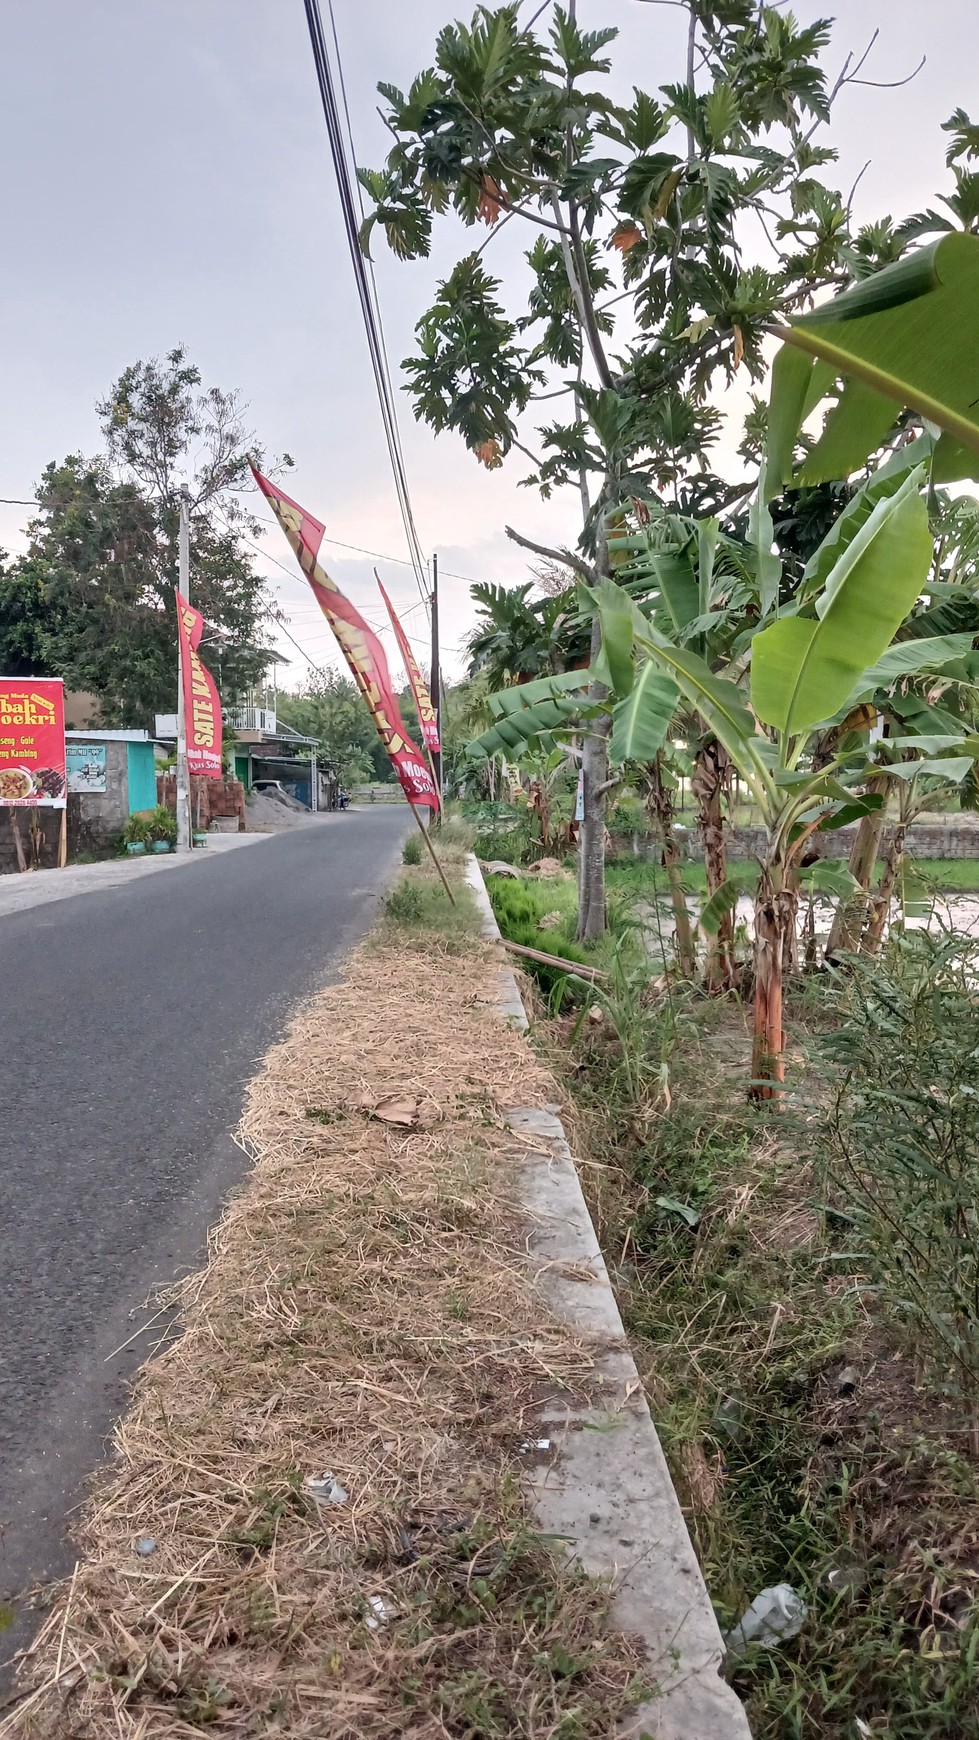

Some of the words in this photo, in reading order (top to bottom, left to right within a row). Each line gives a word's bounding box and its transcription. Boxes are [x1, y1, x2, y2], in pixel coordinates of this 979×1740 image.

[413, 675, 436, 722] SATE
[193, 699, 214, 748] SATE
[20, 736, 34, 745] Gule
[11, 749, 38, 759] Kambing
[206, 760, 220, 769] Solo
